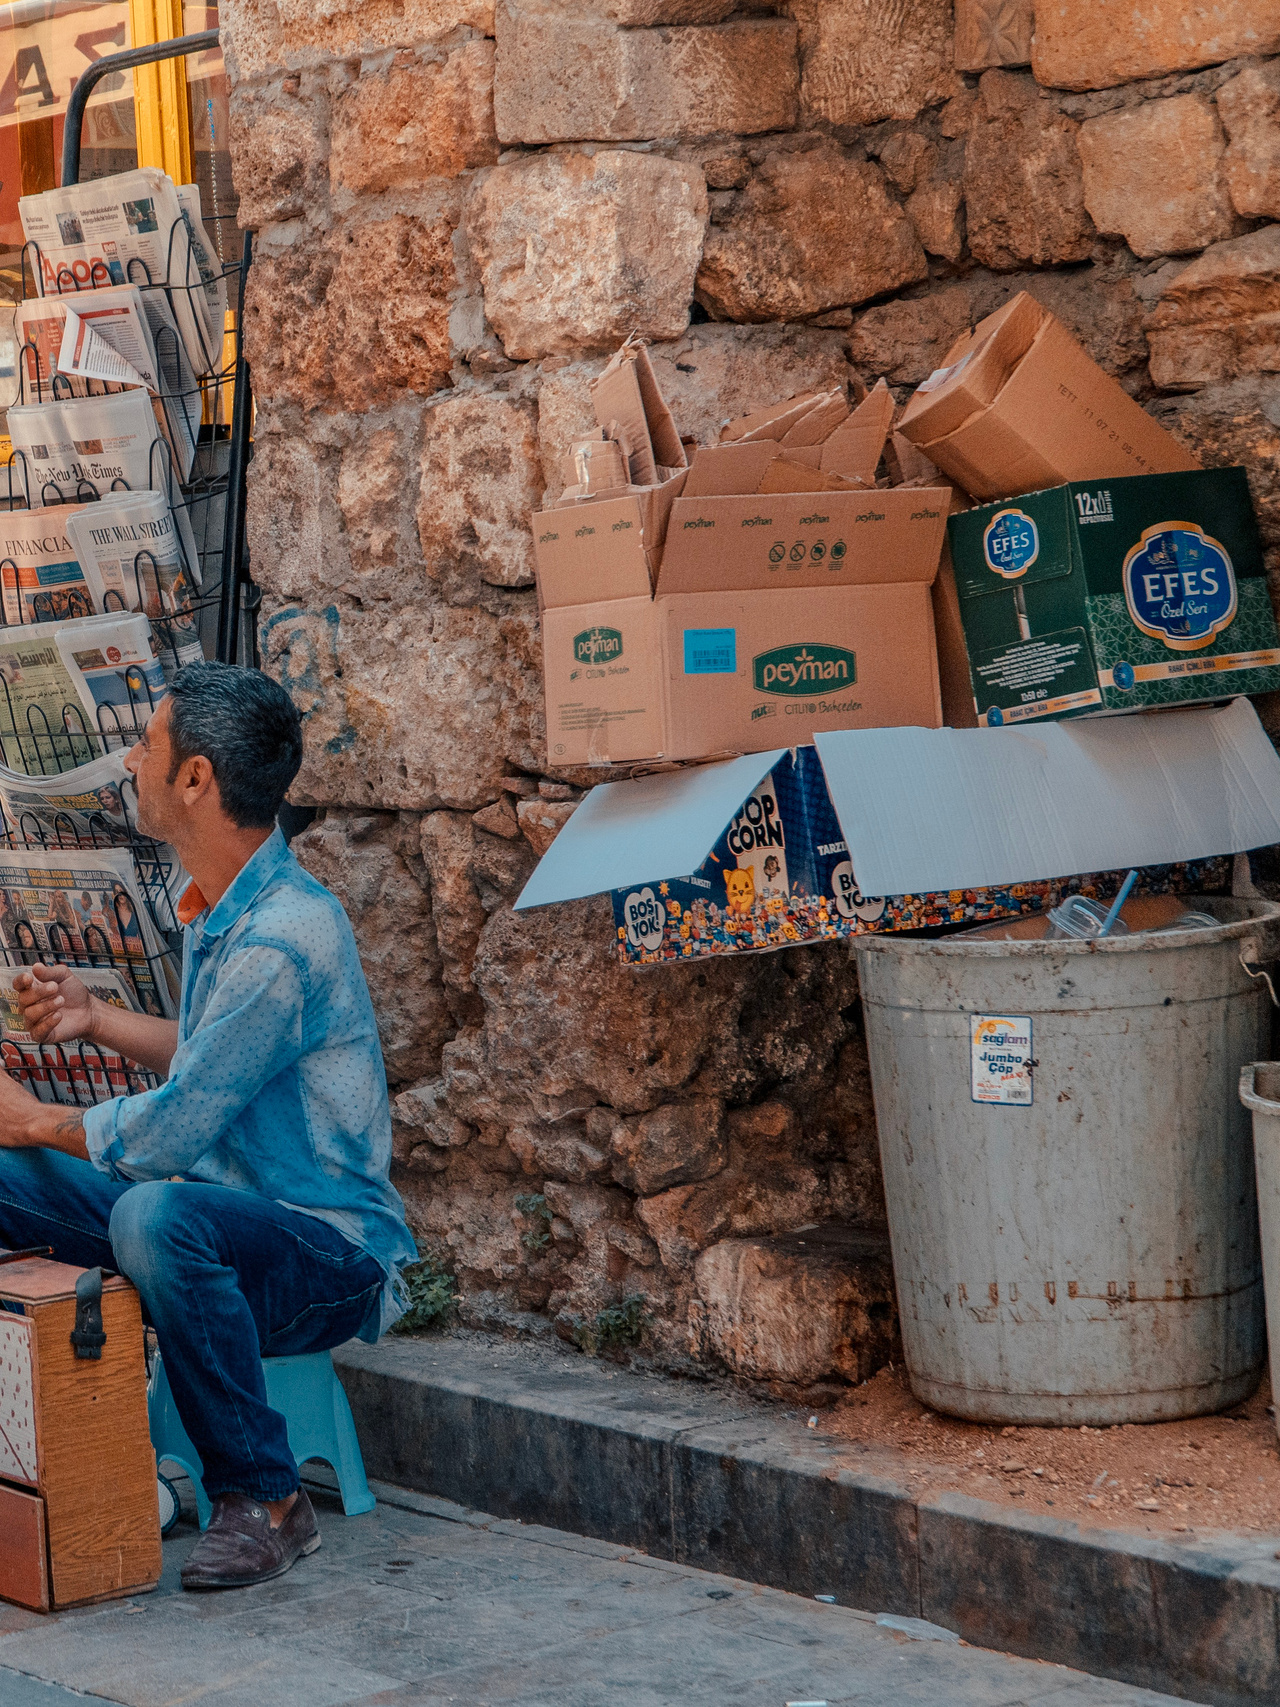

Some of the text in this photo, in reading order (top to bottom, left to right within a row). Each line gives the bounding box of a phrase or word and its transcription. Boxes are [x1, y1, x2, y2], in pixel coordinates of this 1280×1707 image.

[91, 463, 124, 479] Times
[742, 516, 772, 527] peyman
[799, 514, 829, 525] peyman
[855, 512, 885, 523] peyman
[910, 510, 940, 521] peyman
[612, 521, 633, 532] peyman
[684, 519, 715, 530] peyman
[89, 527, 114, 546] THE
[112, 524, 141, 542] WALL
[539, 533, 559, 543] peyman
[575, 528, 595, 538] peyman
[5, 536, 73, 556] FINANCIA
[992, 532, 1030, 555] EFES
[1142, 567, 1219, 603] EFES
[1160, 600, 1208, 619] Özel Seri
[578, 638, 620, 659] peyman
[763, 659, 849, 688] peyman
[818, 699, 863, 714] Bahçeden
[728, 821, 785, 854] CORN
[629, 898, 655, 921] BOŞ
[982, 1033, 1028, 1046] sağlam
[979, 1052, 1022, 1063] Jumbo
[989, 1063, 1013, 1075] Çöp
